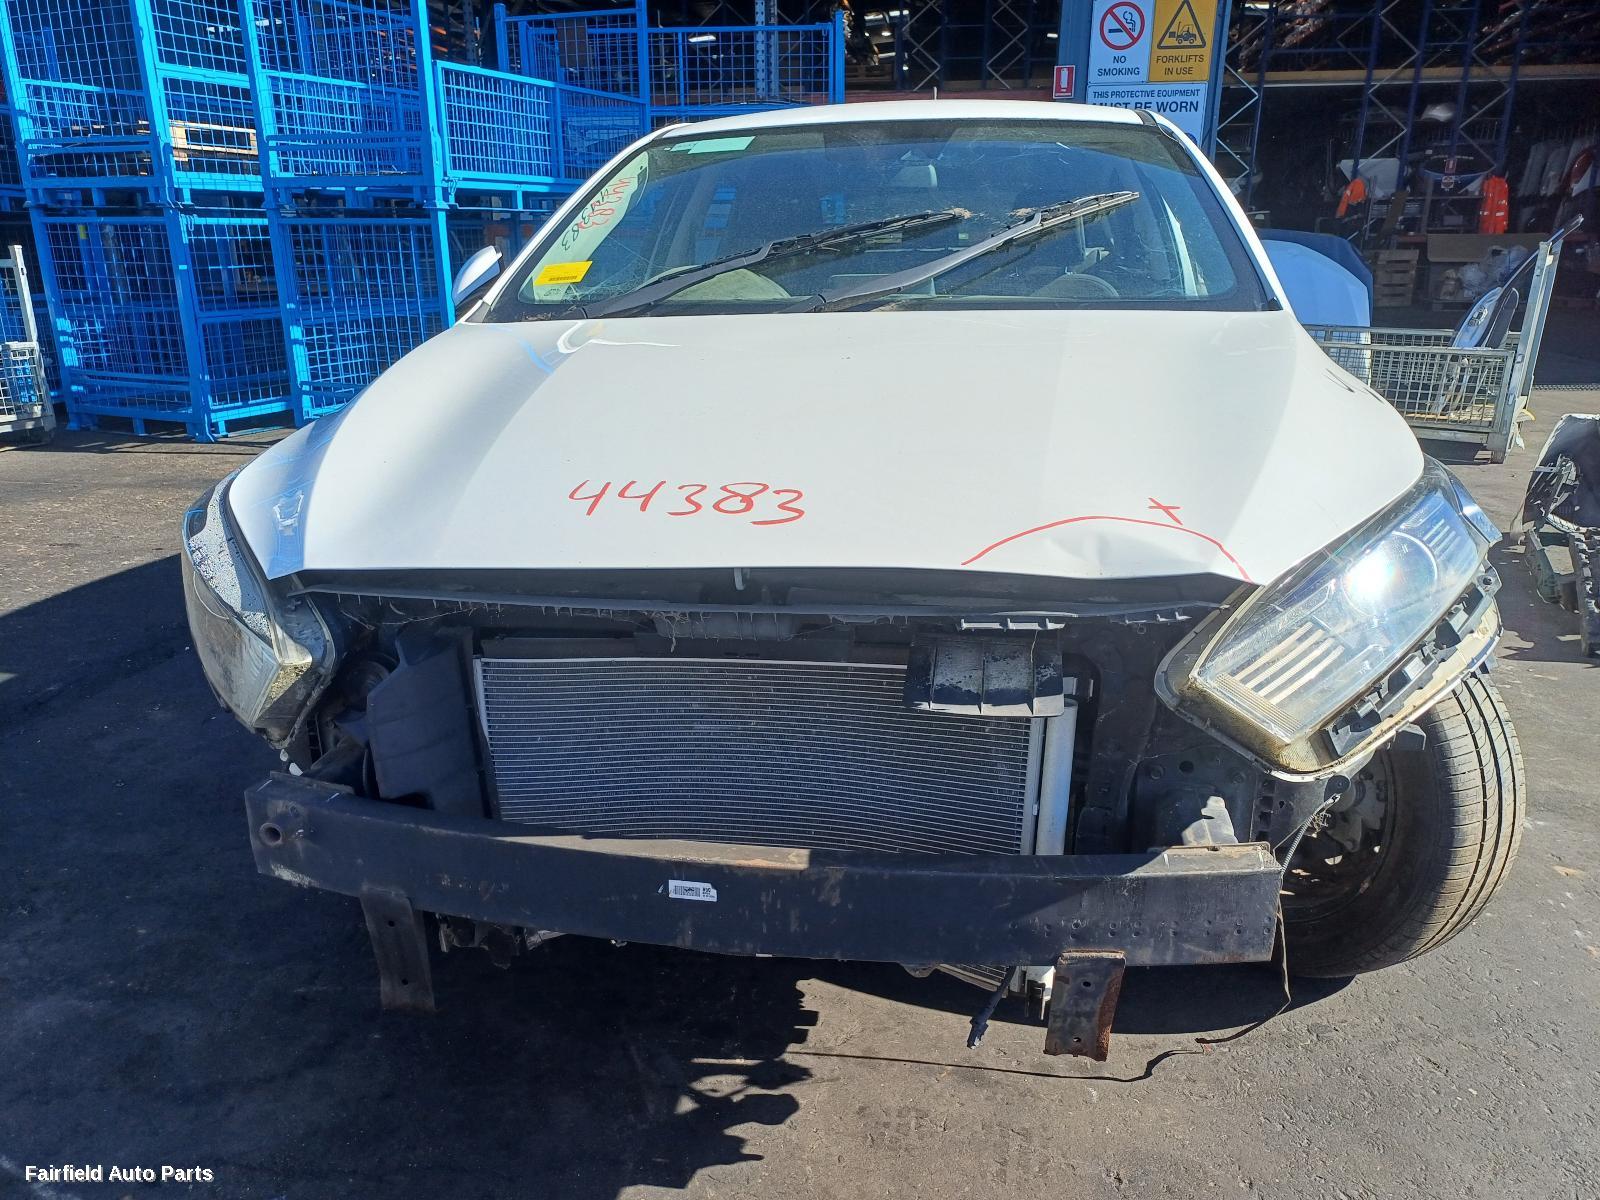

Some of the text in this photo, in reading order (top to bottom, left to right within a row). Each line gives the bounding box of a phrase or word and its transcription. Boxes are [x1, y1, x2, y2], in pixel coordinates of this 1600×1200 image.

[1113, 55, 1126, 64] NO
[1156, 54, 1204, 64] FORKLIFTS
[1097, 67, 1140, 77] SMOKING
[1164, 66, 1193, 76] IN USE
[1093, 88, 1200, 99] THIS PROTECTIVE EQUIPMENT
[1156, 101, 1199, 113] WORN
[568, 479, 805, 525] 44383
